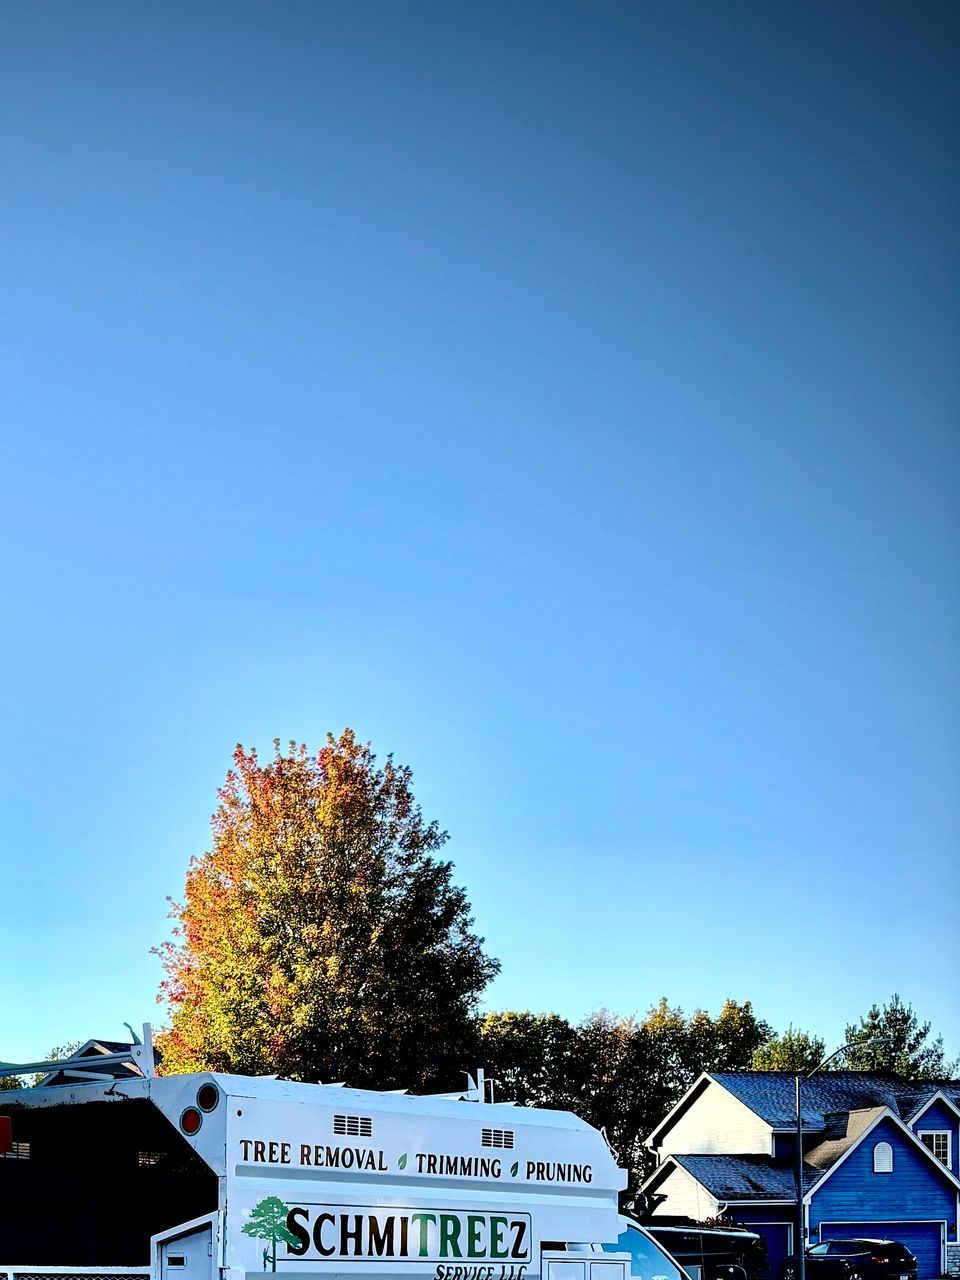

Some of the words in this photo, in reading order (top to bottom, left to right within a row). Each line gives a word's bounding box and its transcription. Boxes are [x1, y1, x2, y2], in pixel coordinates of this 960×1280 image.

[239, 1139, 292, 1164] TREE
[300, 1144, 388, 1171] REMOVAL
[415, 1153, 502, 1178] TRIMMING
[526, 1161, 592, 1183] PRUNING
[286, 1207, 528, 1258] SCHMITREEZ
